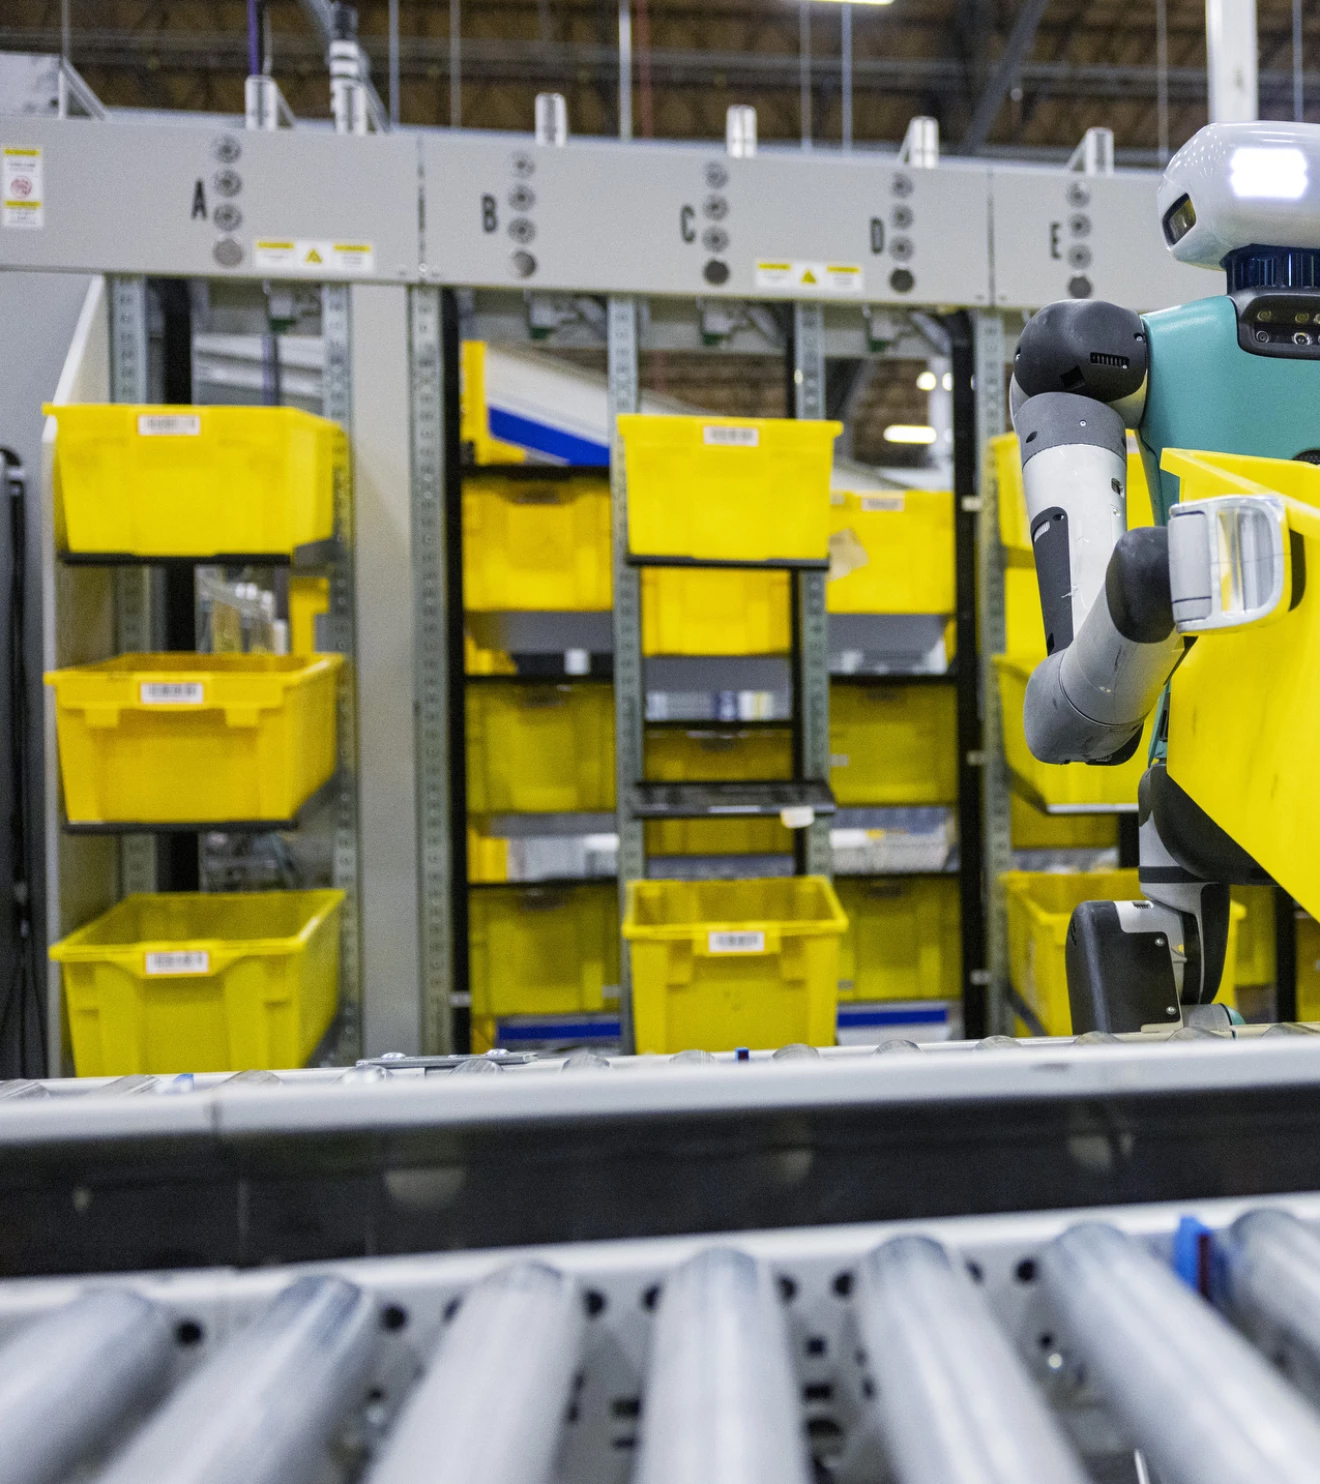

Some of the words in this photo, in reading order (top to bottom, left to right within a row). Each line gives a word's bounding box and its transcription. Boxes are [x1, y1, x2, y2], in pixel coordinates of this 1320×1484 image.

[191, 180, 207, 219] A
[481, 194, 498, 234] B
[680, 204, 697, 244] C
[869, 217, 885, 256] D
[1050, 222, 1063, 260] E
